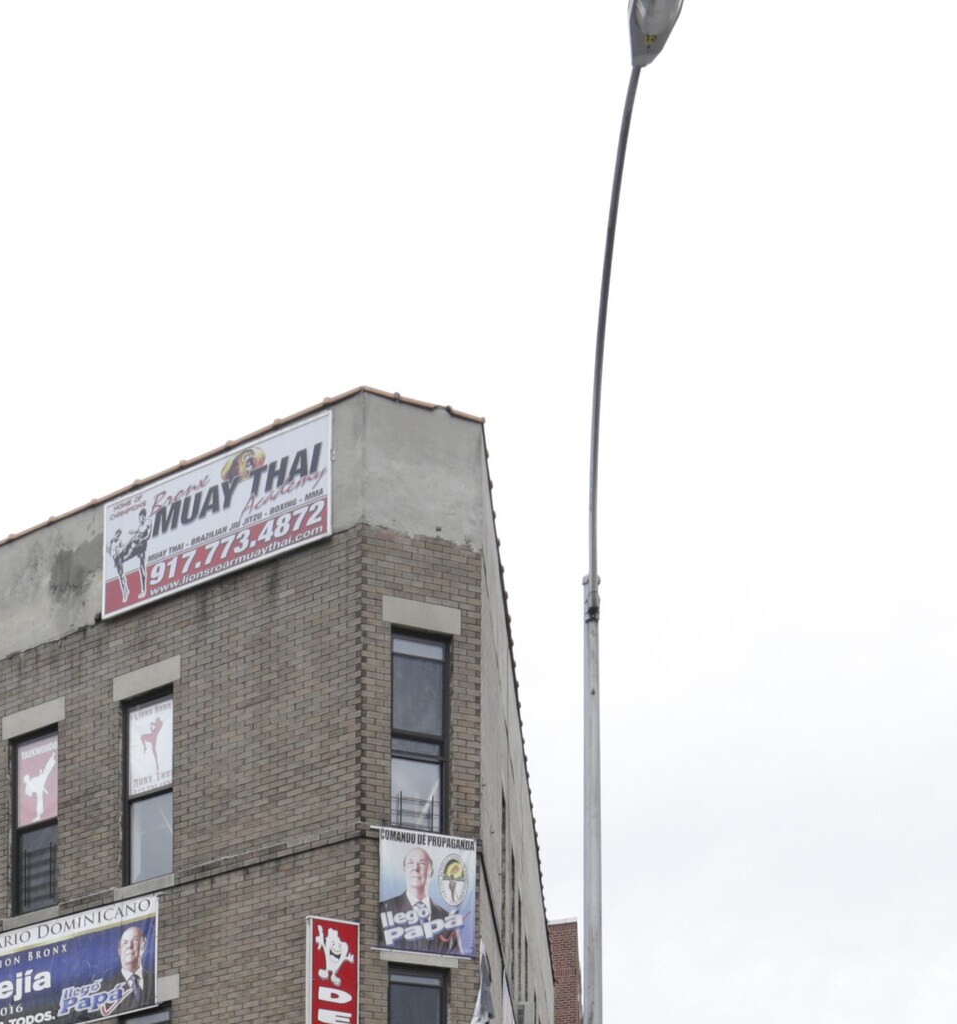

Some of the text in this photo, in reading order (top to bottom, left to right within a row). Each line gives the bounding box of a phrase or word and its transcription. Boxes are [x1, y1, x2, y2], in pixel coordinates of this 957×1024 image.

[109, 500, 147, 520] CHAMPIONS
[113, 495, 143, 512] HOME OF
[149, 474, 210, 517] Bronx
[151, 442, 322, 538] MUAY THAI
[239, 466, 328, 521] Academy
[148, 549, 168, 562] MUAY
[169, 542, 184, 554] THAI
[191, 526, 228, 546] BRAZILIAN
[229, 520, 241, 531] JIU
[242, 512, 262, 526] JITZU
[269, 498, 297, 515] BOXING
[305, 488, 324, 501] MMA
[149, 500, 325, 586] 917.773.4872
[149, 526, 324, 596] www.lionsroarmuaythai.com
[21, 741, 58, 760] TAEKWONDO
[157, 770, 172, 782] THA
[380, 829, 475, 851] COMANDO DE PROPAGANDA
[37, 898, 151, 939] DOMINICANO
[27, 943, 68, 962] BRONX
